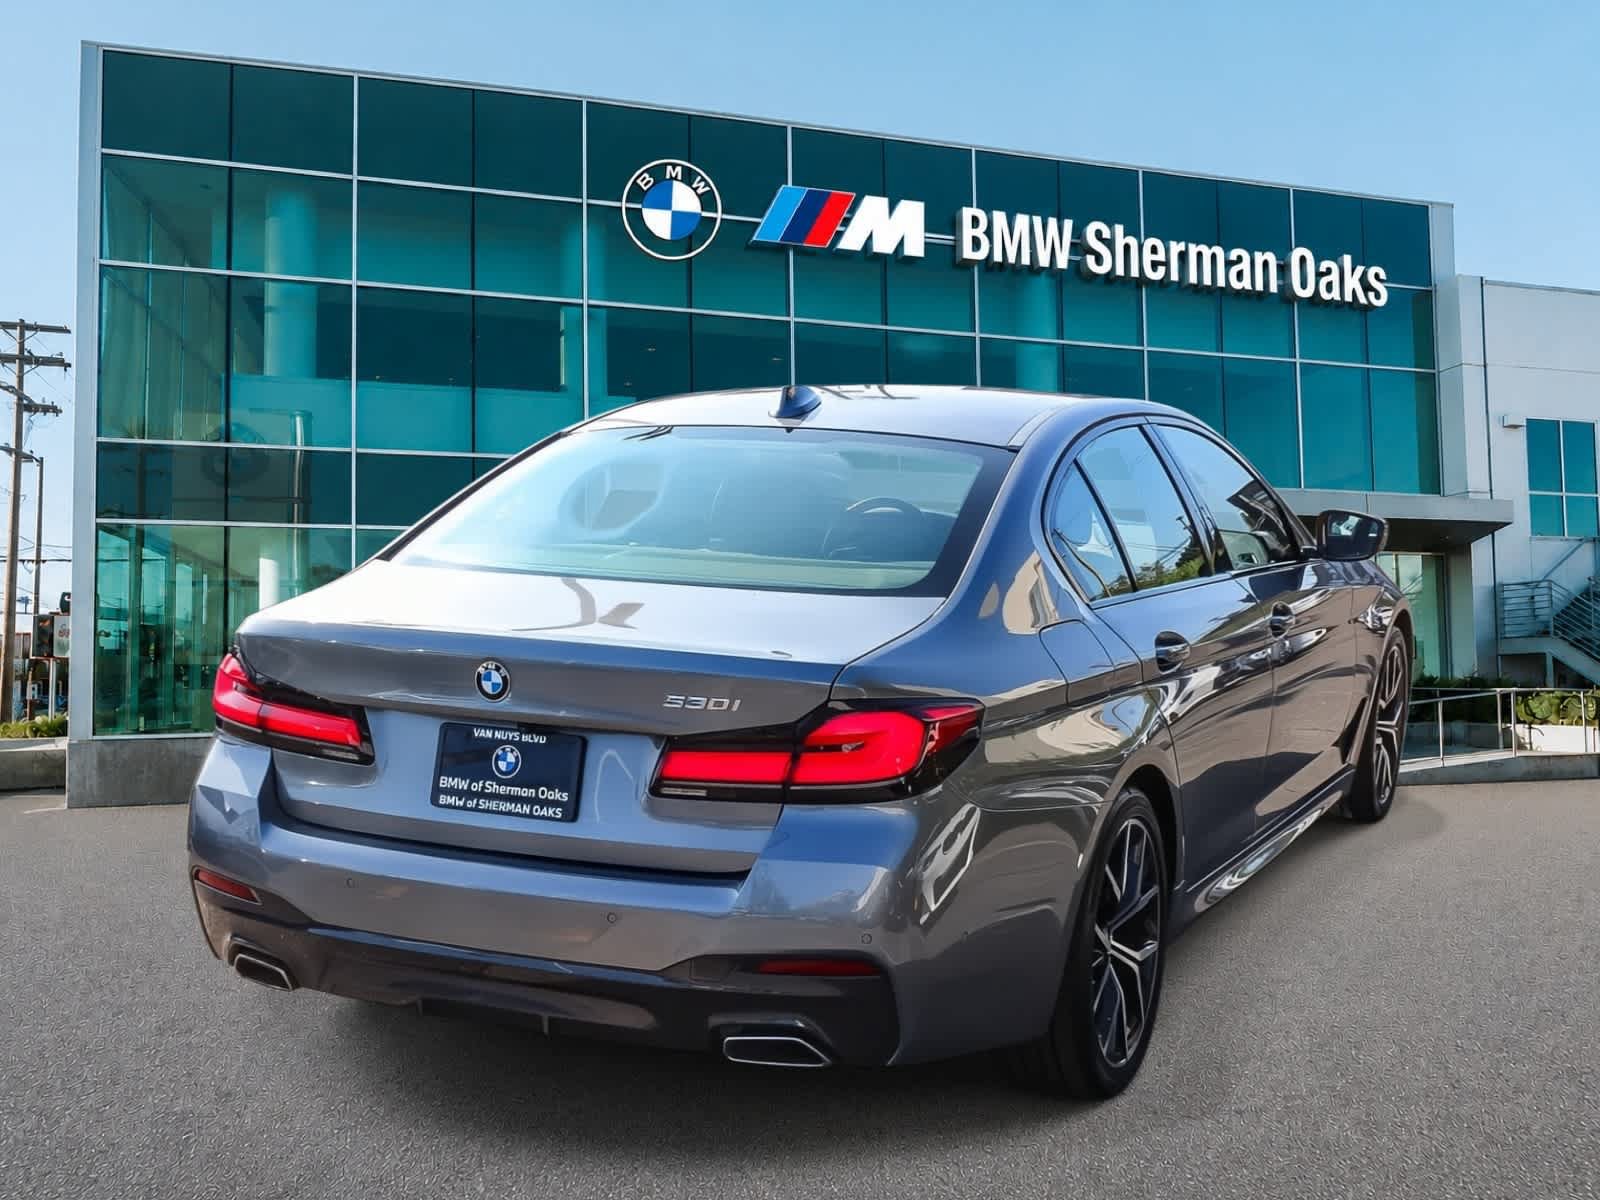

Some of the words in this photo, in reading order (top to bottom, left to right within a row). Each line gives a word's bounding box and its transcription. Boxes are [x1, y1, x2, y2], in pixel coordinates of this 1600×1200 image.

[636, 165, 711, 195] BMW
[836, 195, 925, 258] M
[960, 206, 1074, 270] BMW
[1084, 220, 1279, 294] Sherman
[1288, 246, 1389, 308] Oaks
[473, 727, 493, 739] VAN
[494, 730, 521, 741] NUYS
[521, 733, 547, 744] BLVD
[439, 775, 469, 790] BMW
[470, 780, 484, 792] of
[484, 780, 536, 798] Sherman
[538, 786, 569, 802] Oaks
[439, 794, 465, 807] BMW
[466, 798, 478, 808] of
[478, 799, 531, 815] SHERMAN
[532, 805, 563, 818] OAKS
